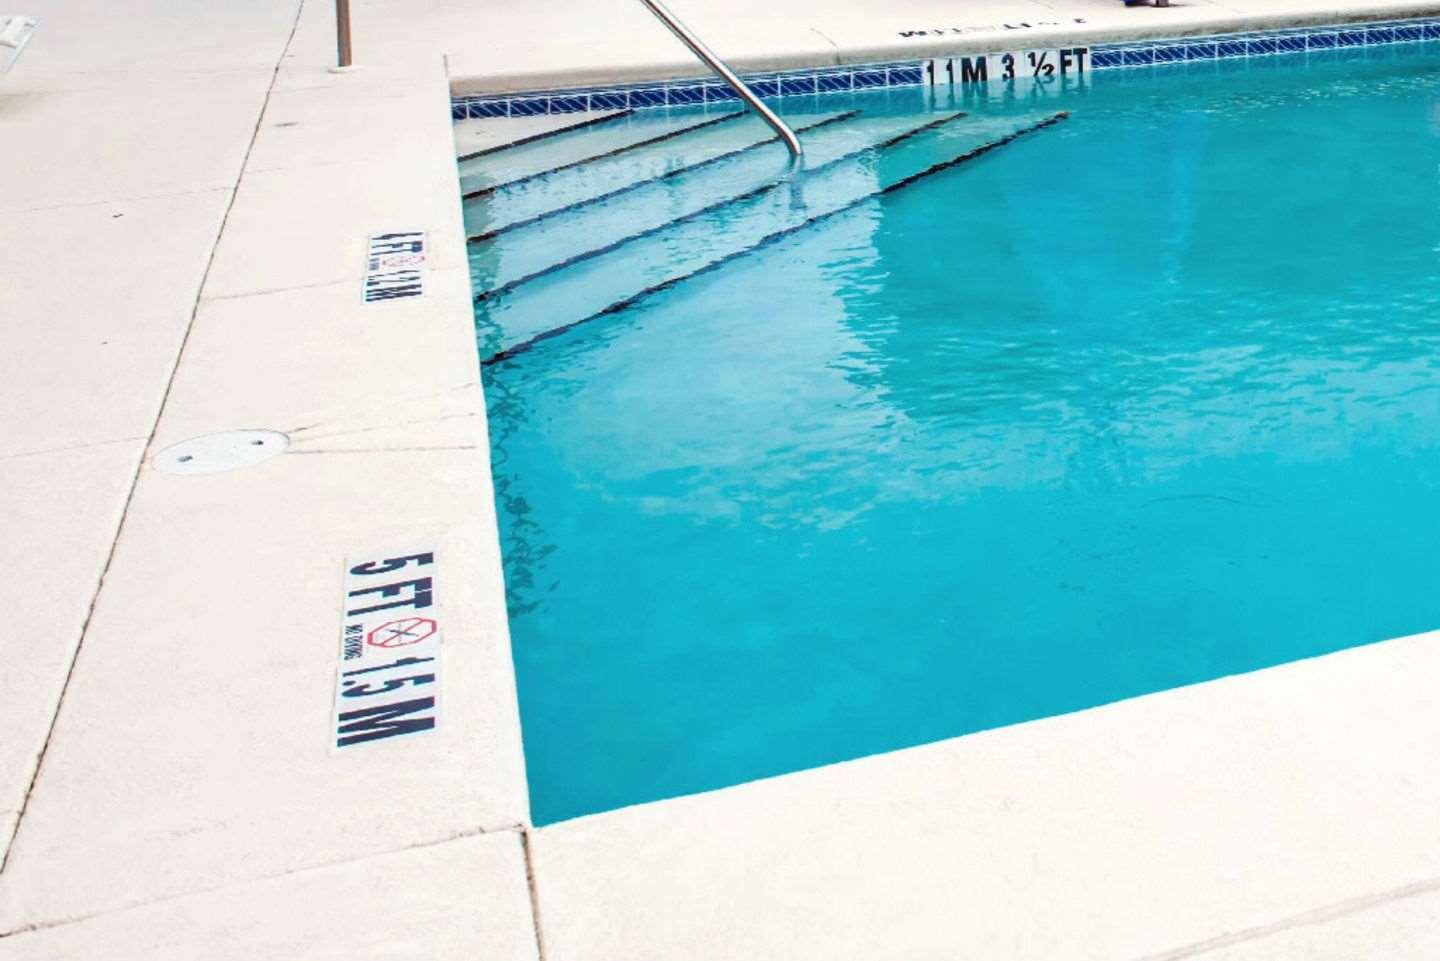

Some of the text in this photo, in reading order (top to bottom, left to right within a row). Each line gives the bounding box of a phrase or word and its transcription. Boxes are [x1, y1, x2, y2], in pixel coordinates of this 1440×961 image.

[1002, 52, 1016, 79] 3
[1060, 47, 1088, 74] FT
[347, 552, 434, 617] 5 FT
